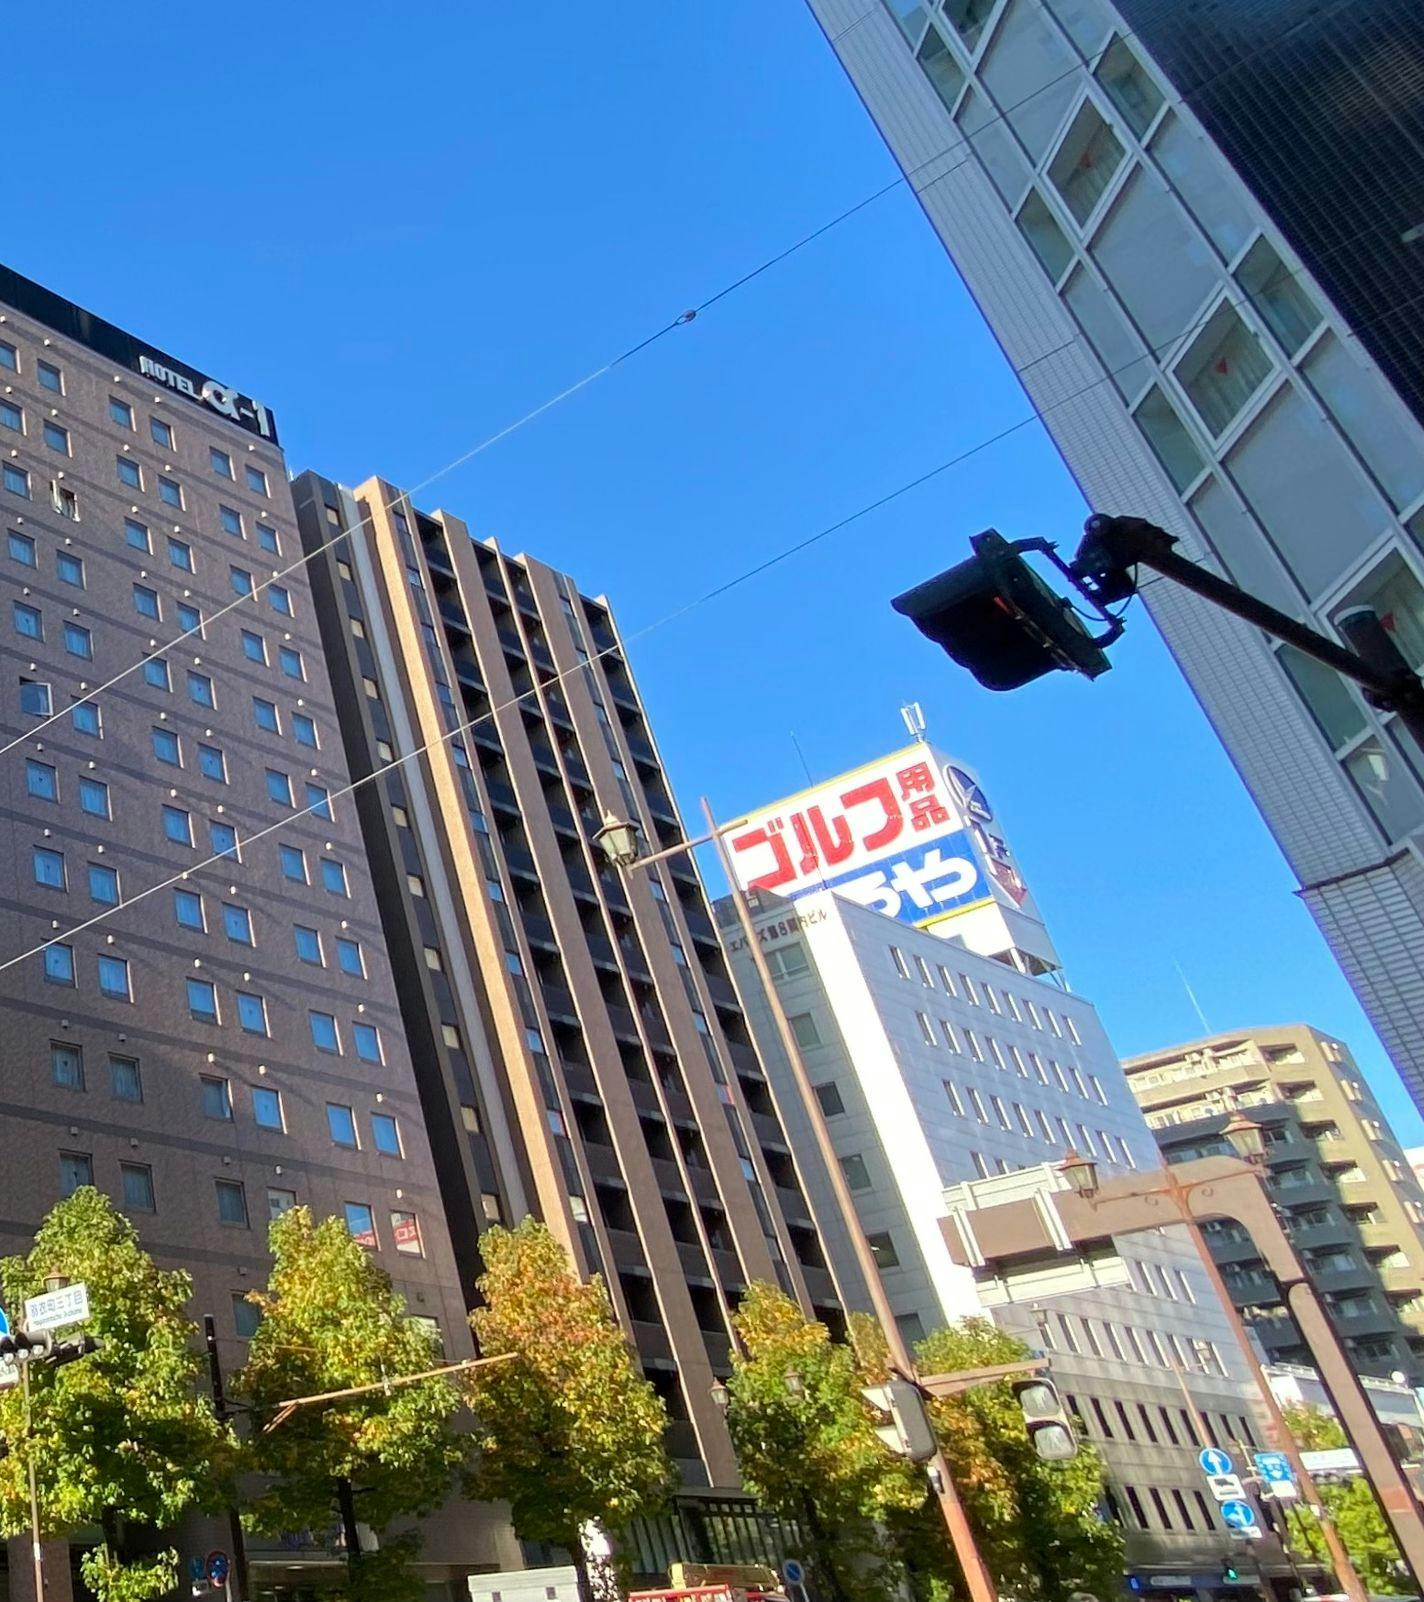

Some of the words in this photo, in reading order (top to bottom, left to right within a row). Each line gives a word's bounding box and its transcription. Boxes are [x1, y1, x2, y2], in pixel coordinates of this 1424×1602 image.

[139, 355, 206, 400] HOTEL
[732, 777, 903, 890] ゴルフ
[896, 762, 950, 832] 用品
